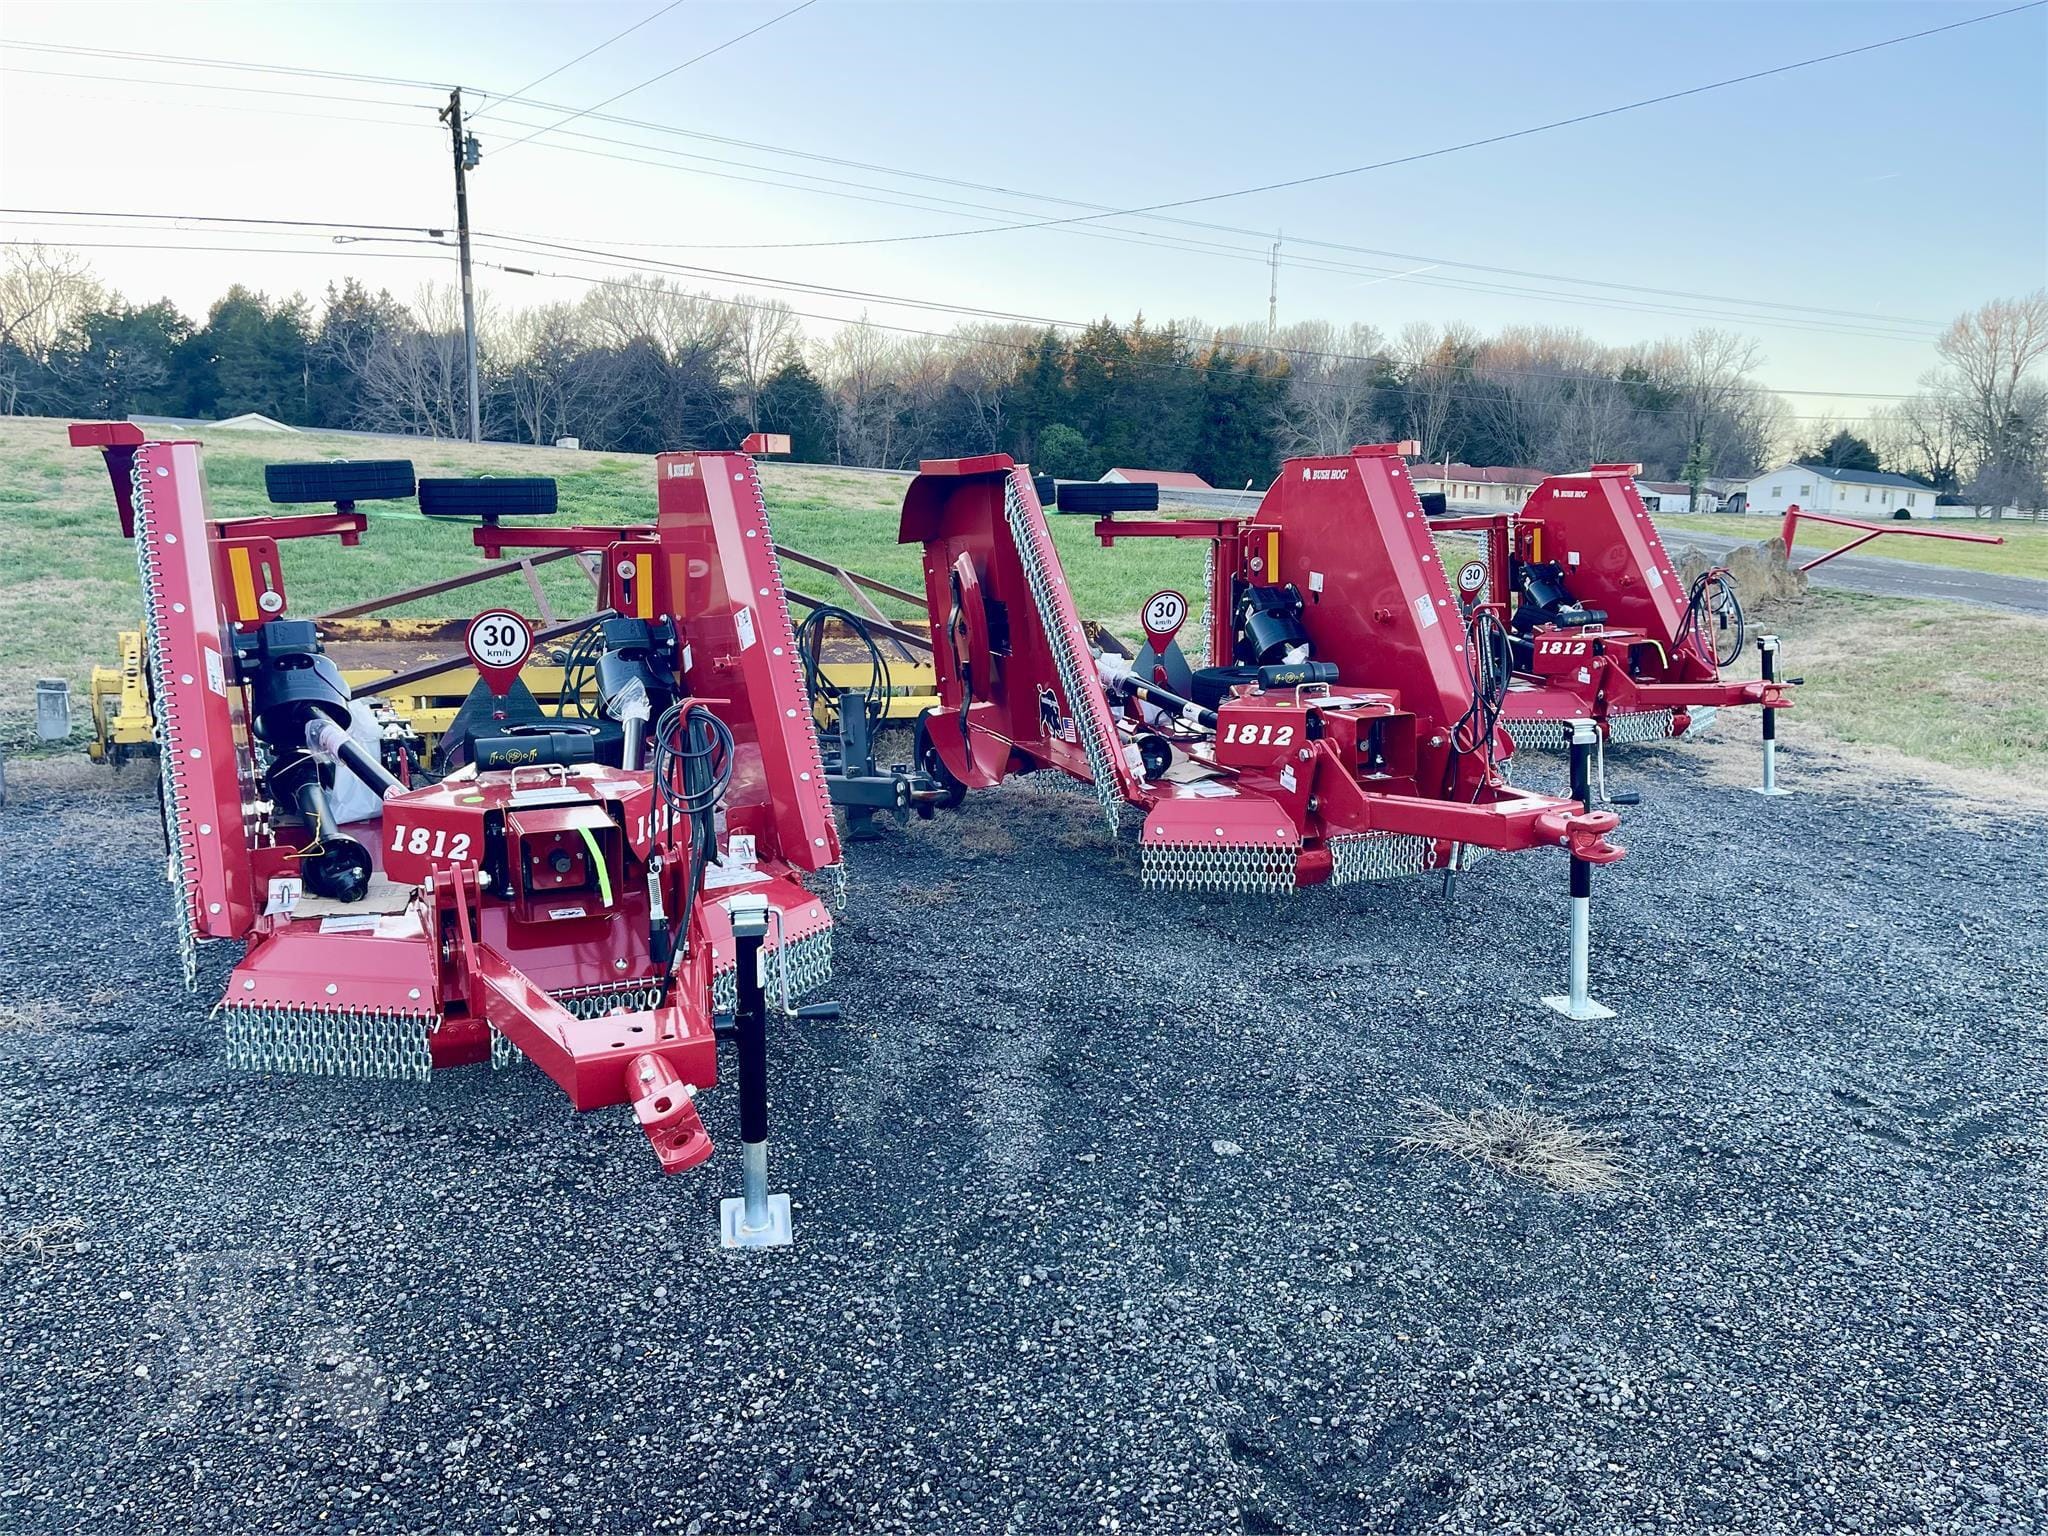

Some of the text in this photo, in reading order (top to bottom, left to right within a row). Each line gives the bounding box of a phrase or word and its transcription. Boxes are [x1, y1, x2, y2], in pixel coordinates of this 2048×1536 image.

[1312, 469, 1330, 480] BUSH
[1465, 569, 1480, 580] 30
[1154, 601, 1176, 617] 30
[483, 625, 515, 646] 30
[487, 649, 511, 657] km/h
[1539, 641, 1586, 655] 1812
[1223, 724, 1294, 746] 1812
[391, 825, 471, 861] 1812
